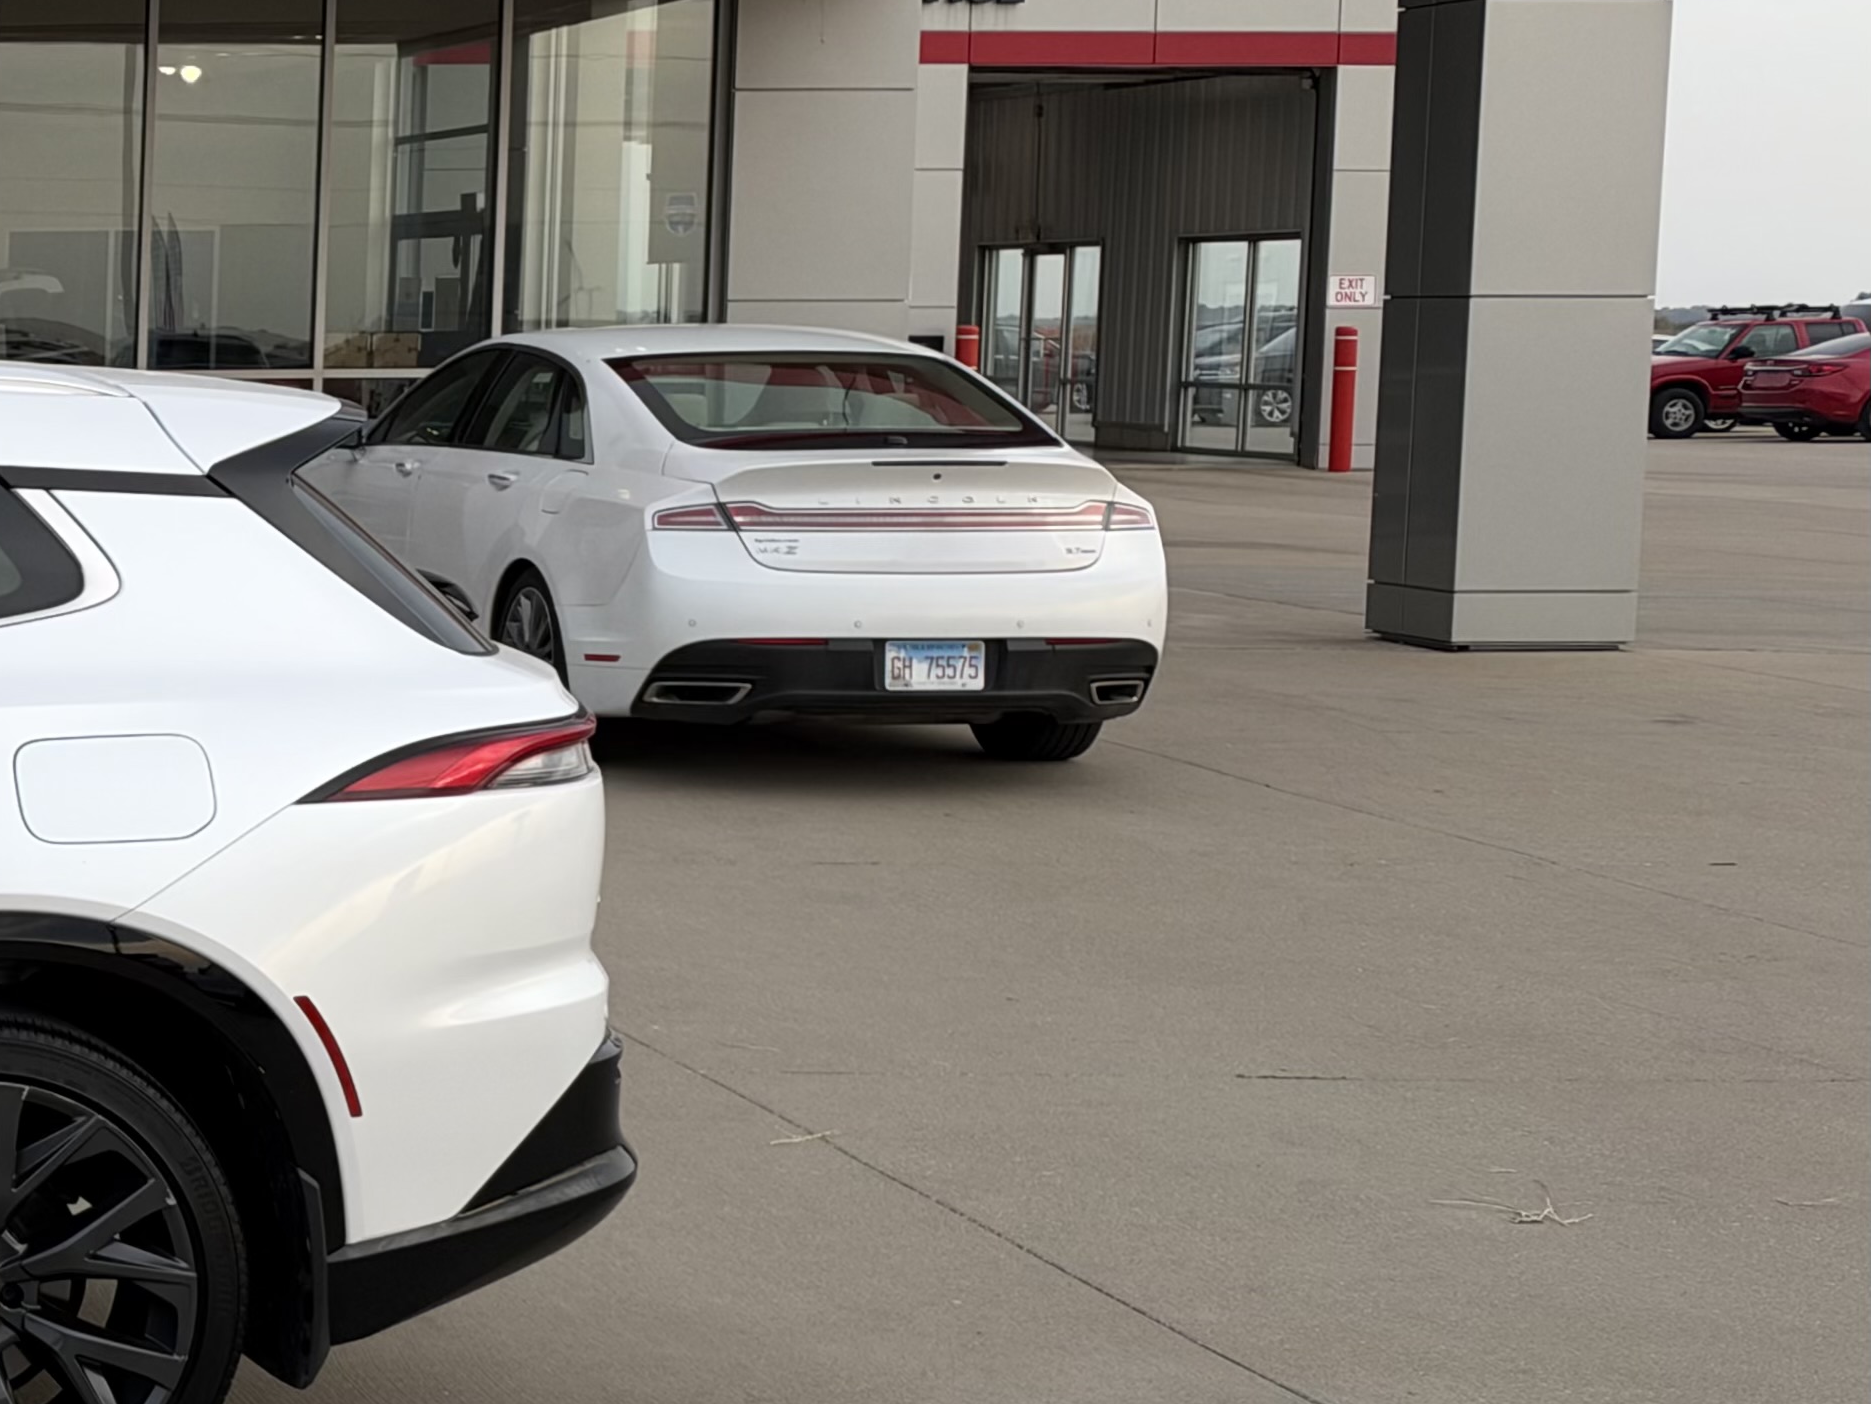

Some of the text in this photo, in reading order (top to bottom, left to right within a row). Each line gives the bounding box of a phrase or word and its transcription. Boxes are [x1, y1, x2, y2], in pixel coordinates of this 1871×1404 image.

[1339, 278, 1365, 290] EXIT
[1335, 291, 1368, 303] ONLY
[891, 656, 979, 680] GH 75575
